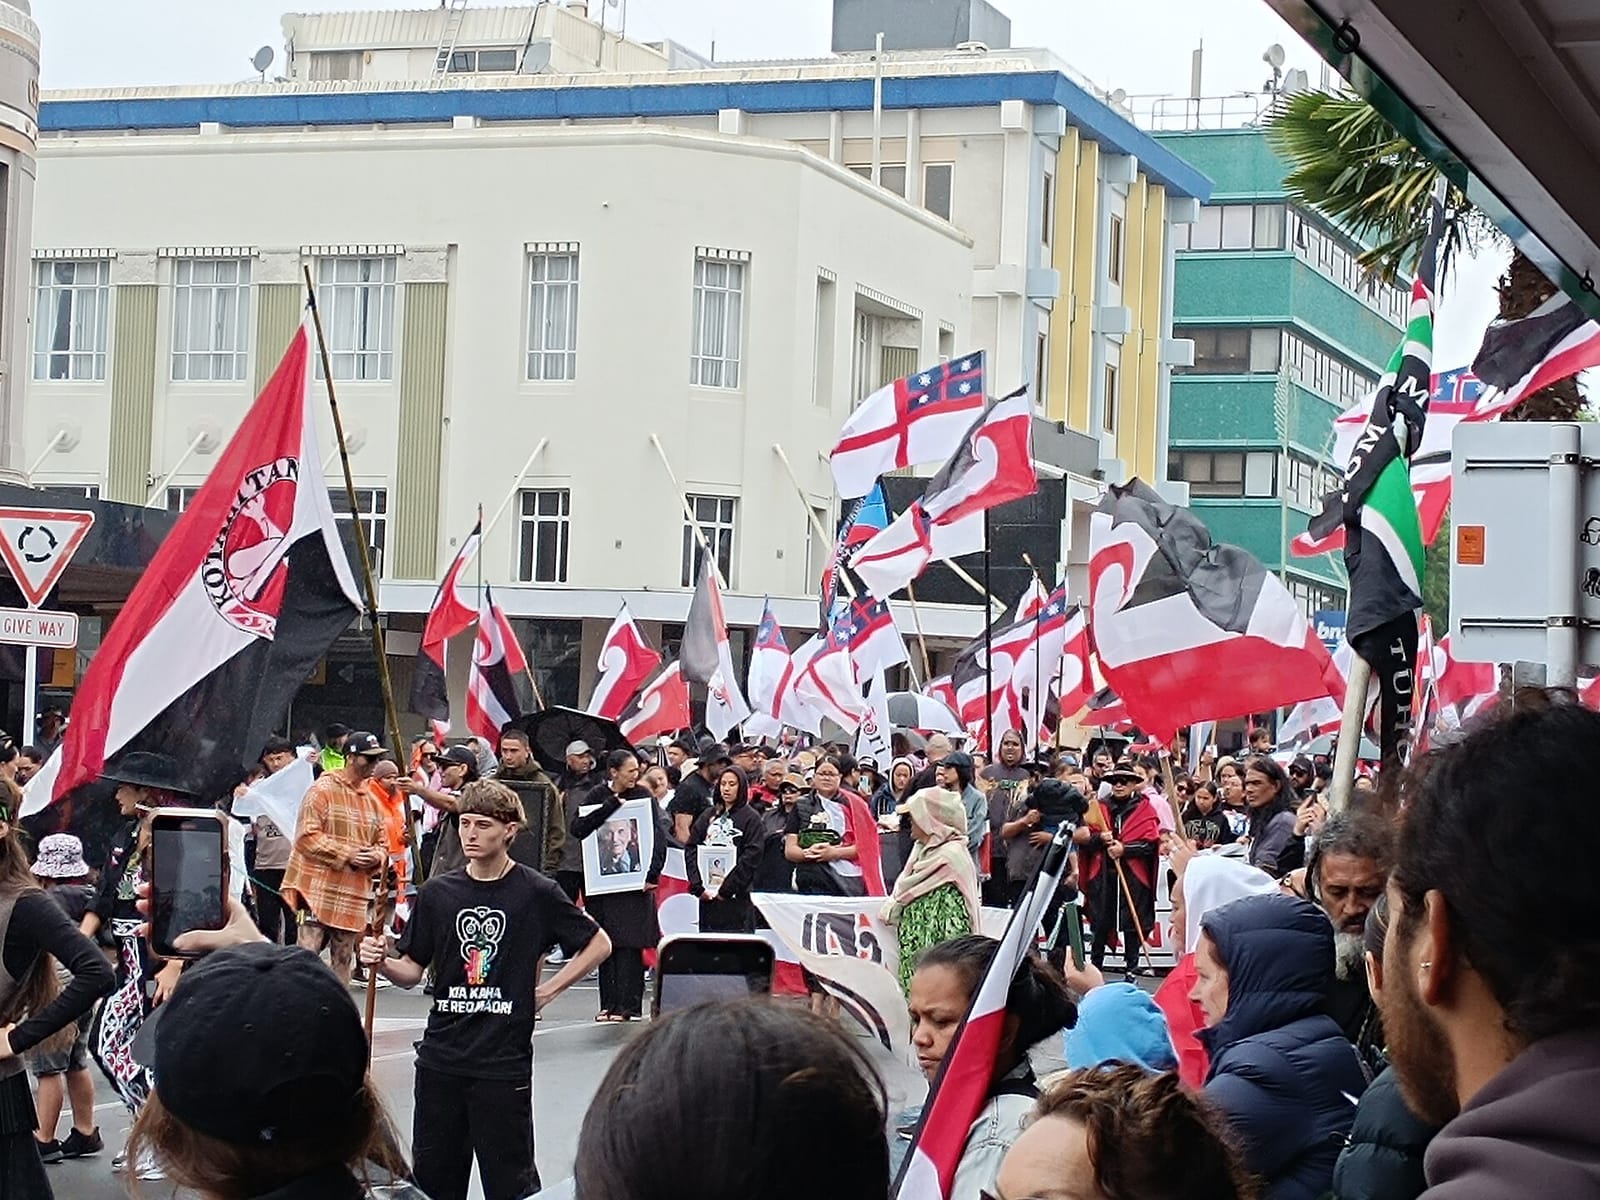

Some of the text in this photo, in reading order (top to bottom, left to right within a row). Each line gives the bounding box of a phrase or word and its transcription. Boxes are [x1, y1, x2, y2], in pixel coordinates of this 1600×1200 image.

[4, 617, 64, 636] GIVE WAY
[448, 986, 502, 999] KIA KAHA
[436, 1000, 449, 1012] TE
[450, 1001, 475, 1013] REO
